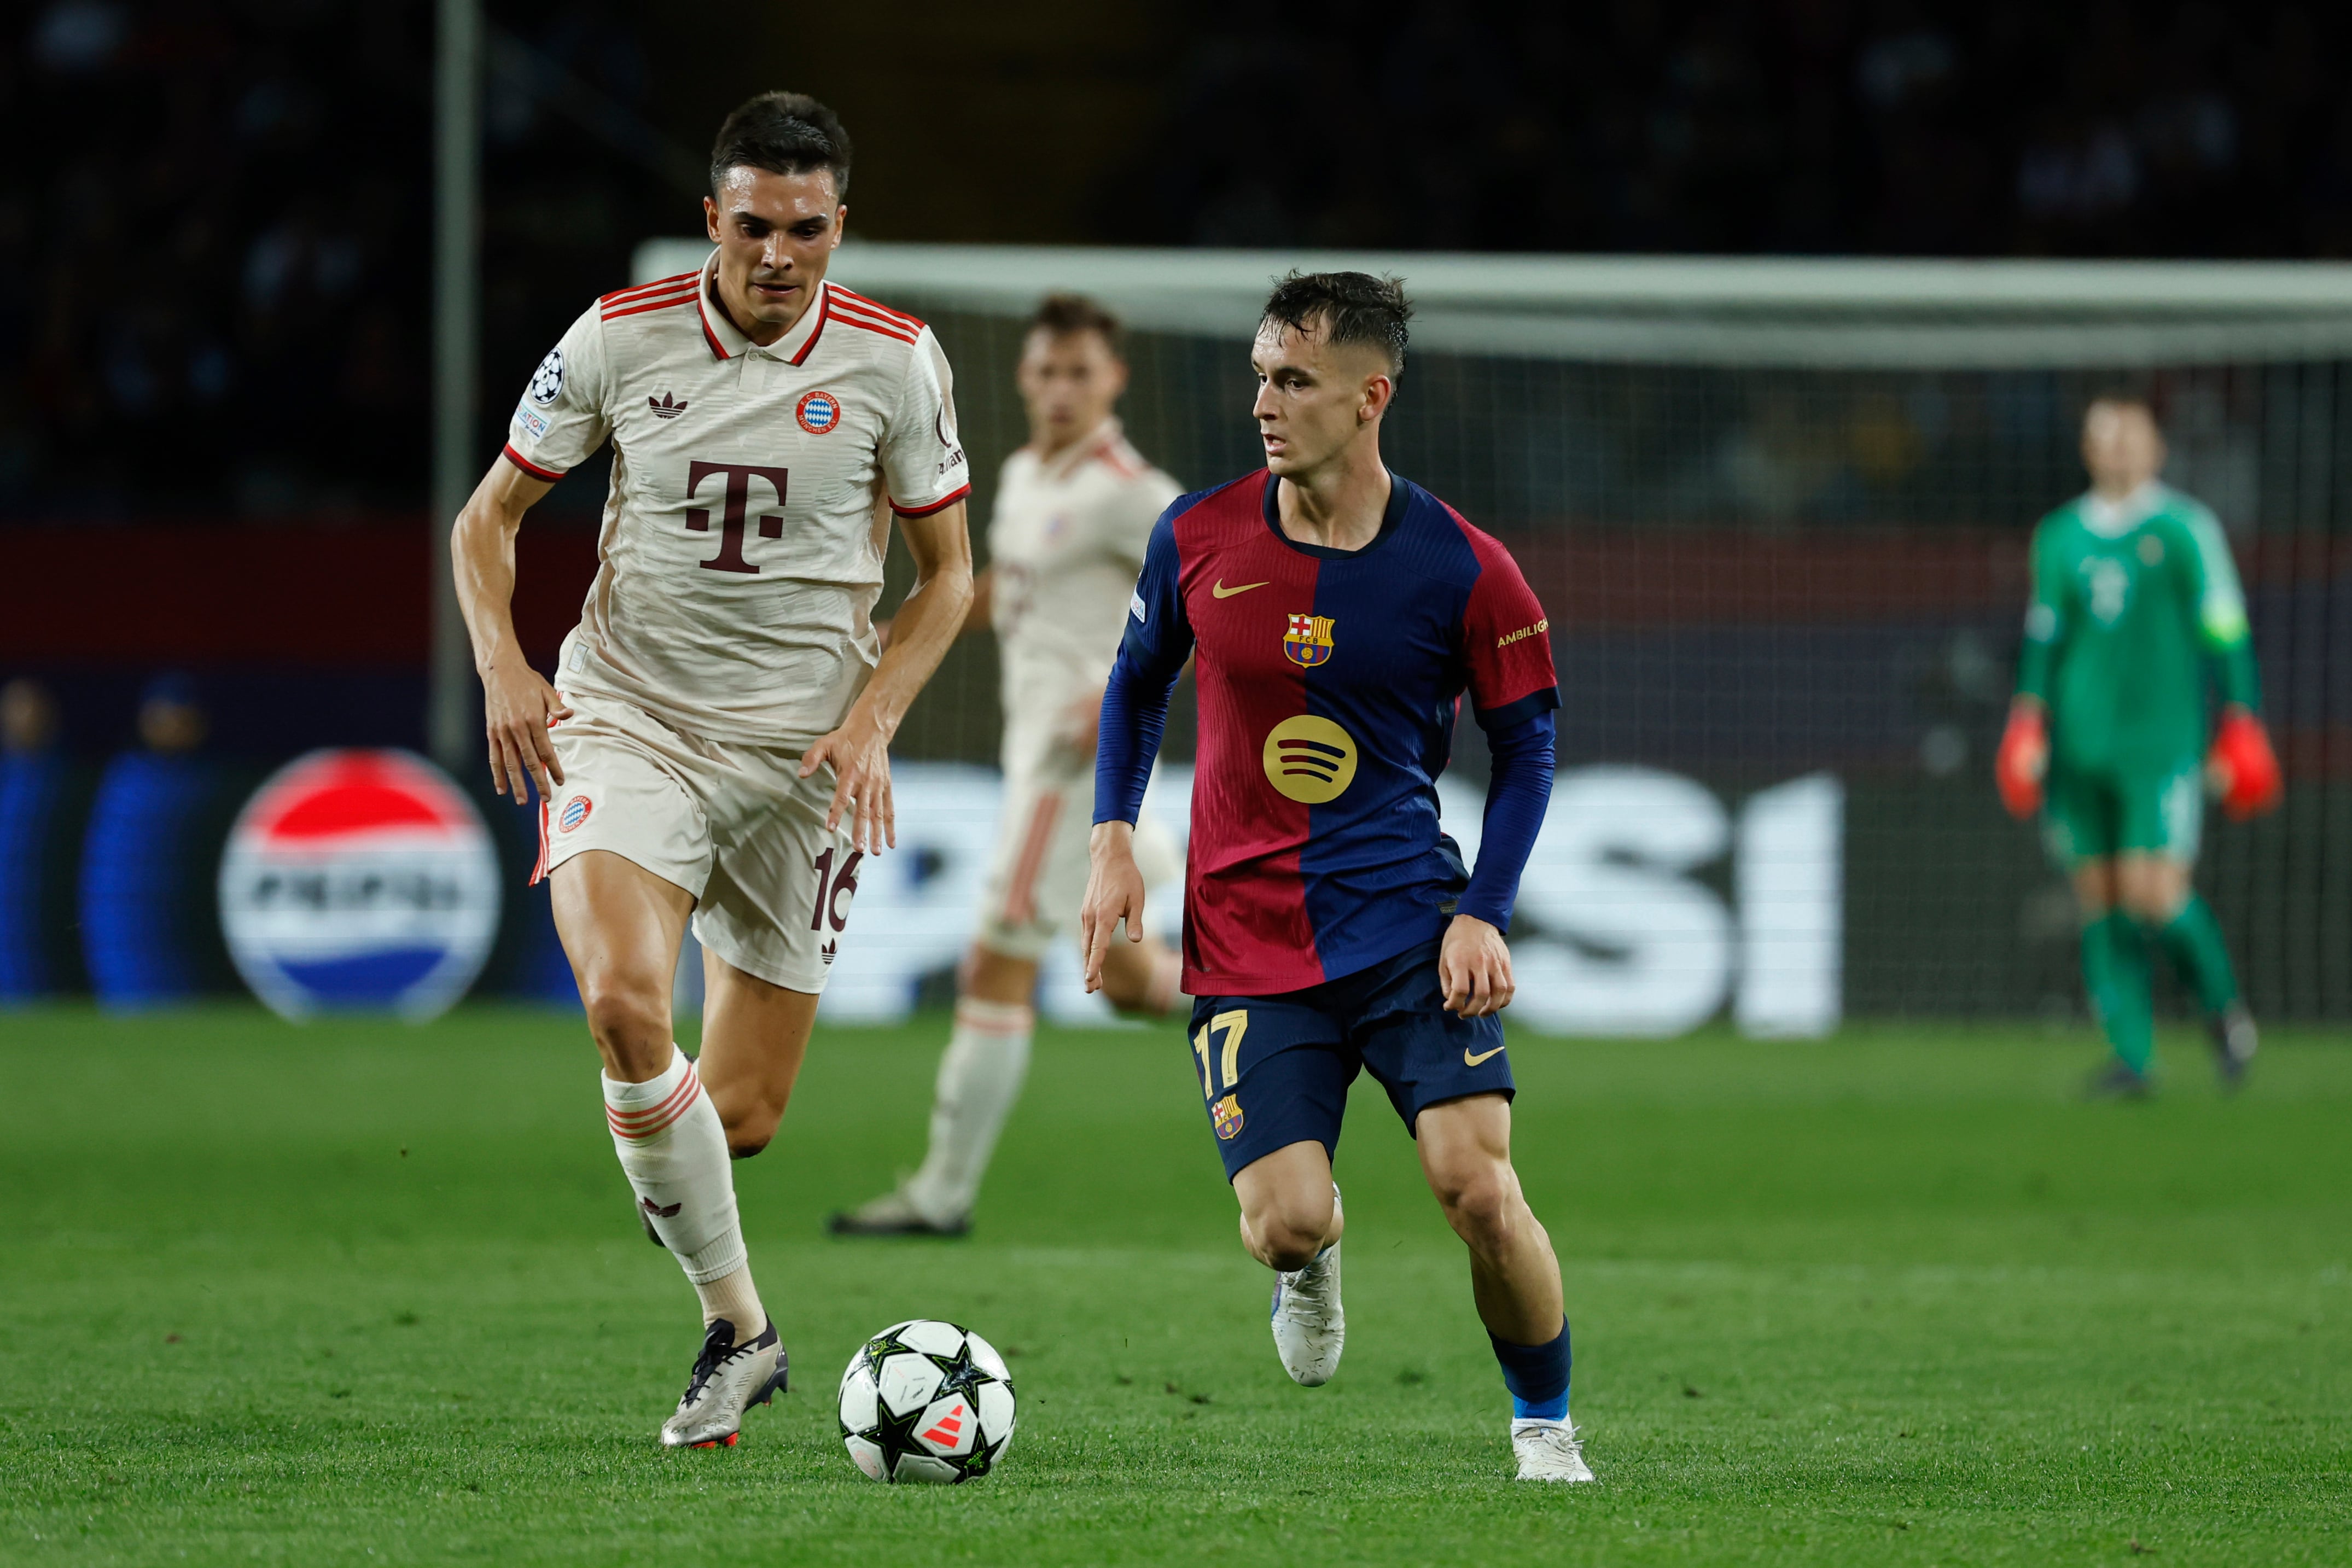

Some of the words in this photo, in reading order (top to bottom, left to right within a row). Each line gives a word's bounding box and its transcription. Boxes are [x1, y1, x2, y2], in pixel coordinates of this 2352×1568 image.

[798, 415, 826, 433] MÜNCHEN
[815, 392, 839, 409] BAYERN
[685, 461, 788, 574] T
[1498, 618, 1548, 648] AMBILIGH
[811, 847, 864, 932] 16
[1194, 1010, 1248, 1101] 17
